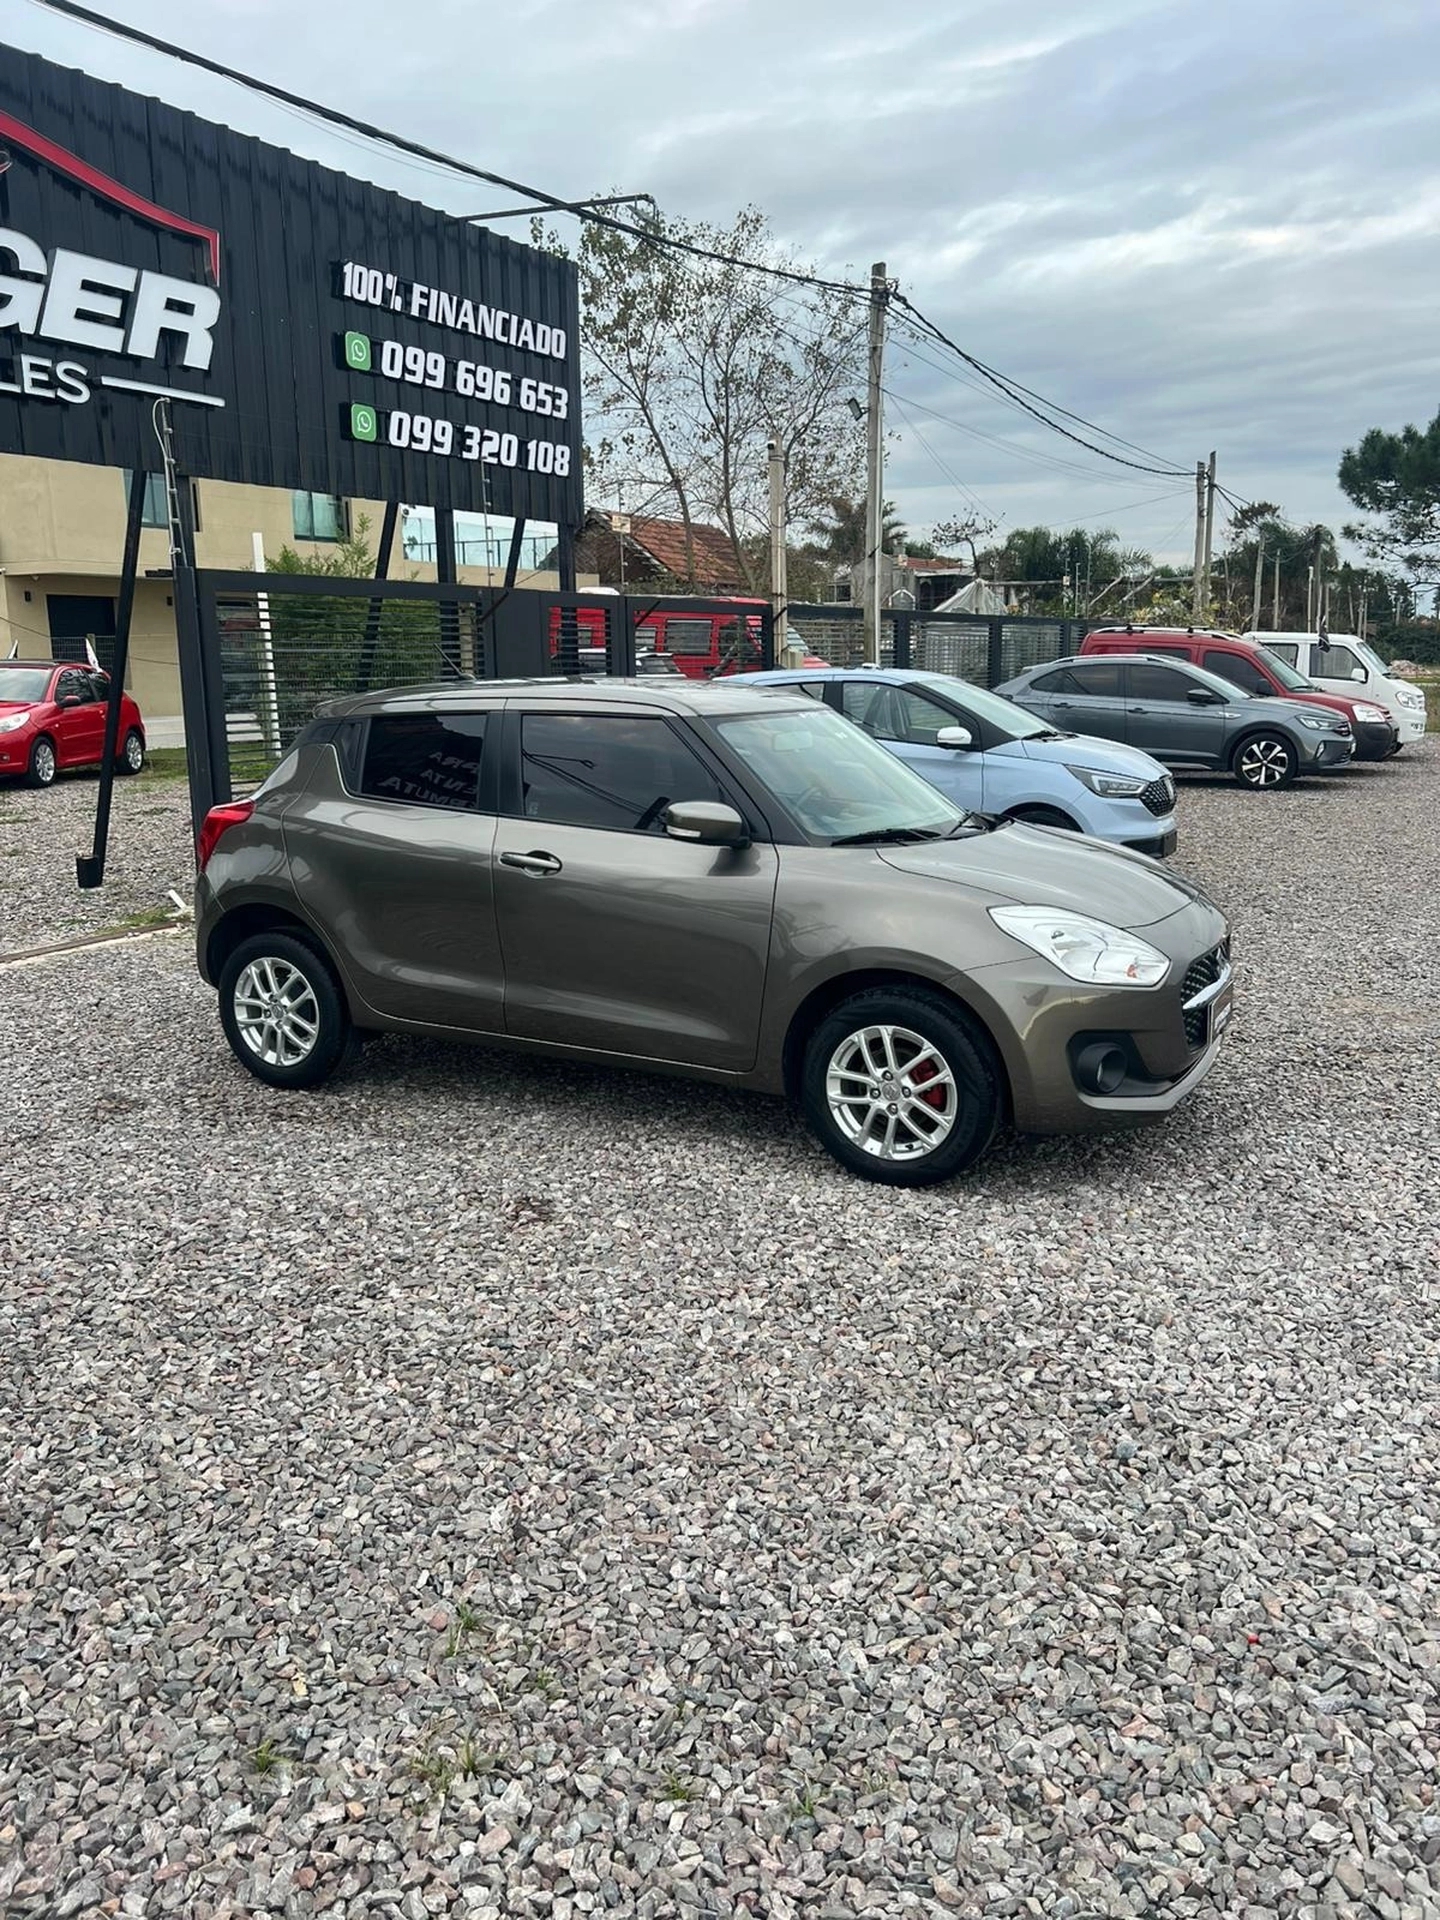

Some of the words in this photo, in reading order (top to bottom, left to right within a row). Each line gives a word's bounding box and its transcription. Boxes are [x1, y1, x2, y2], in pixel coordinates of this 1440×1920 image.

[343, 261, 402, 312] 100%
[410, 282, 567, 360] FINANCIADO
[381, 340, 446, 389] 099
[456, 360, 511, 406] 696
[519, 377, 569, 420] 653
[388, 410, 453, 456] 099
[462, 425, 518, 468] 320
[527, 439, 571, 477] 108
